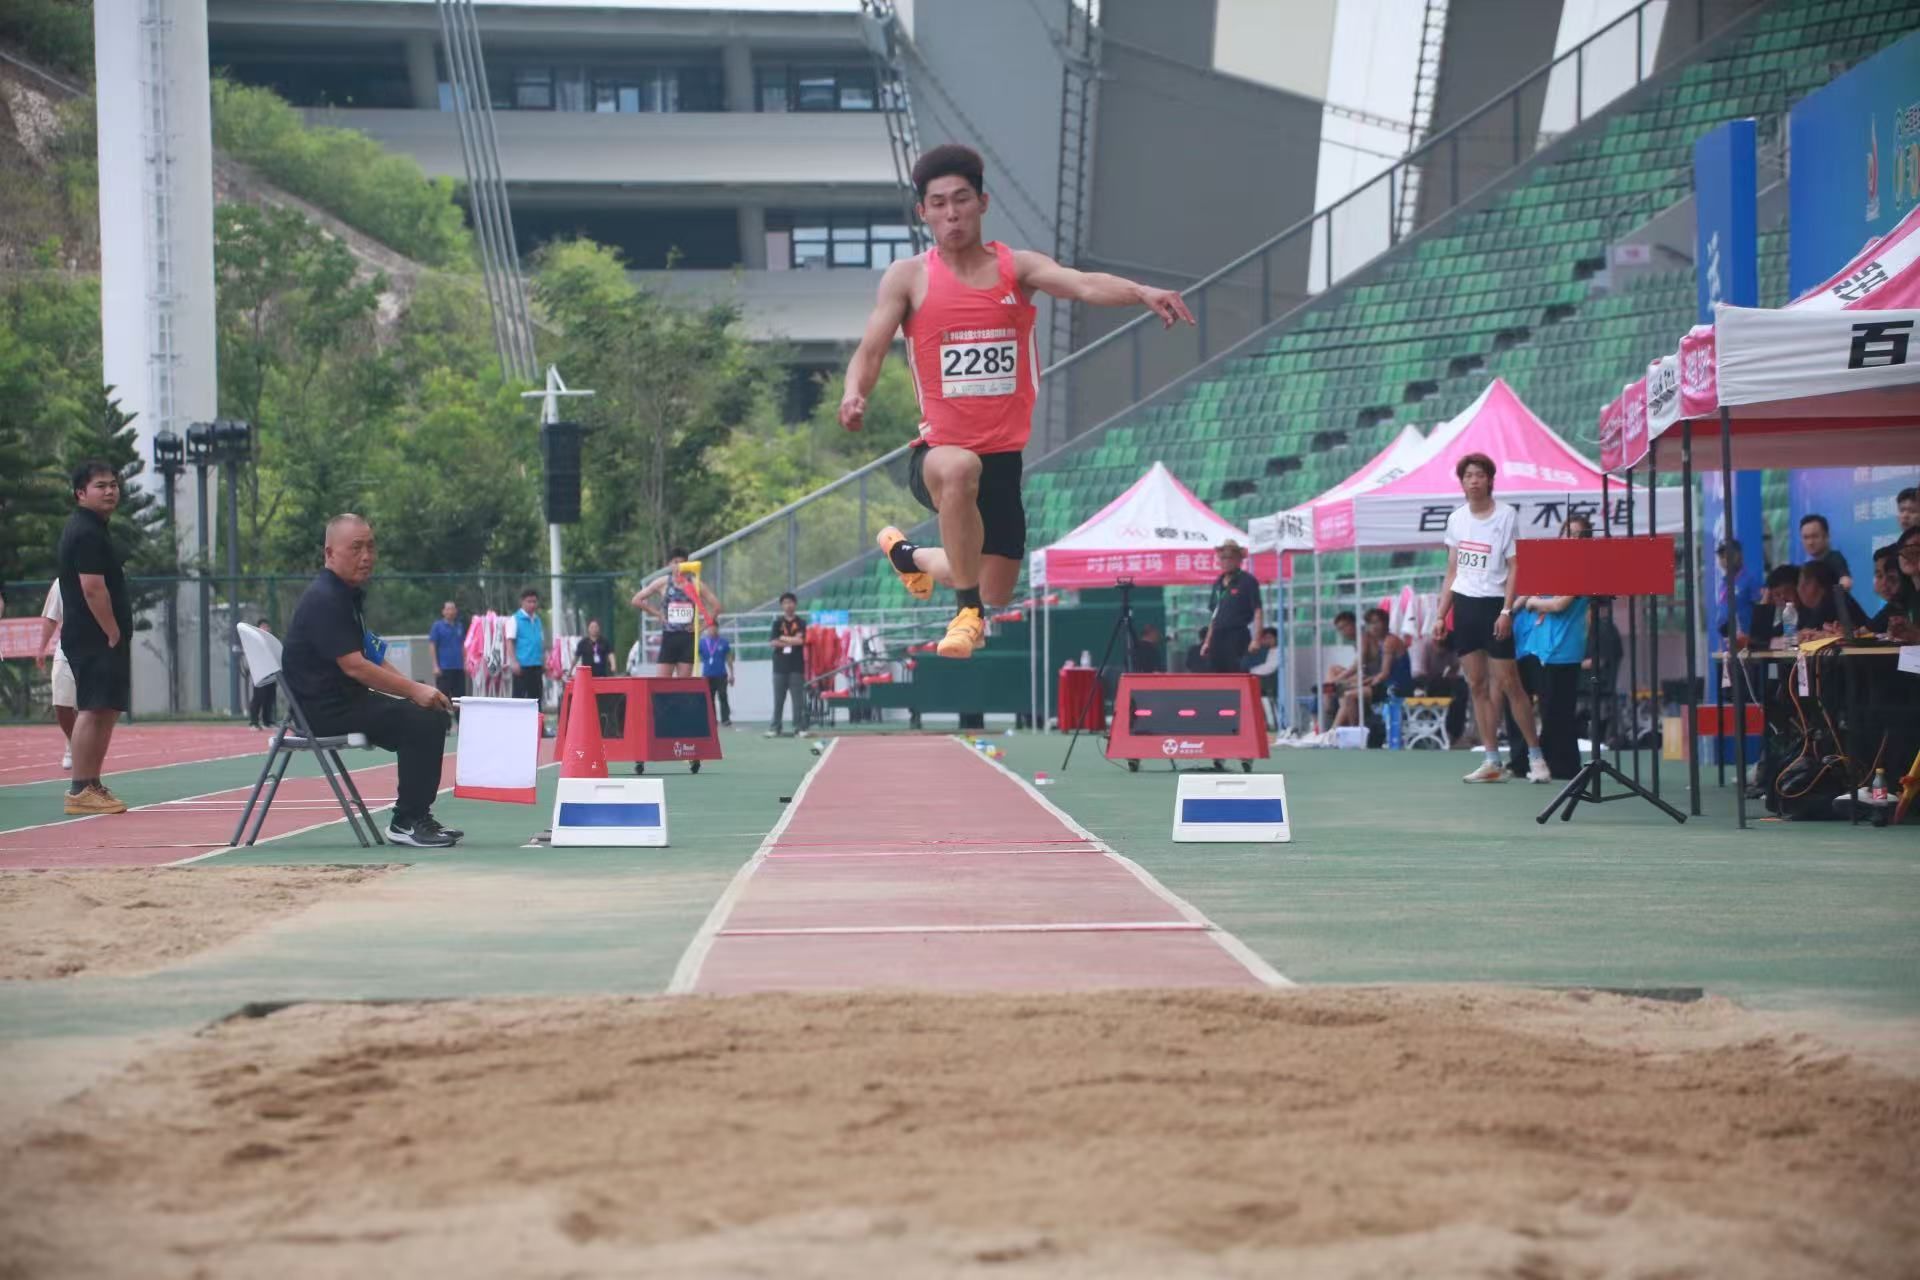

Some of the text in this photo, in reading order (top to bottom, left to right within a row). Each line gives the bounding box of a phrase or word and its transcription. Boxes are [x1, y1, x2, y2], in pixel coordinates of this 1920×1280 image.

[1848, 320, 1914, 369] 百
[944, 346, 1015, 376] 2285
[1458, 551, 1488, 568] 2031
